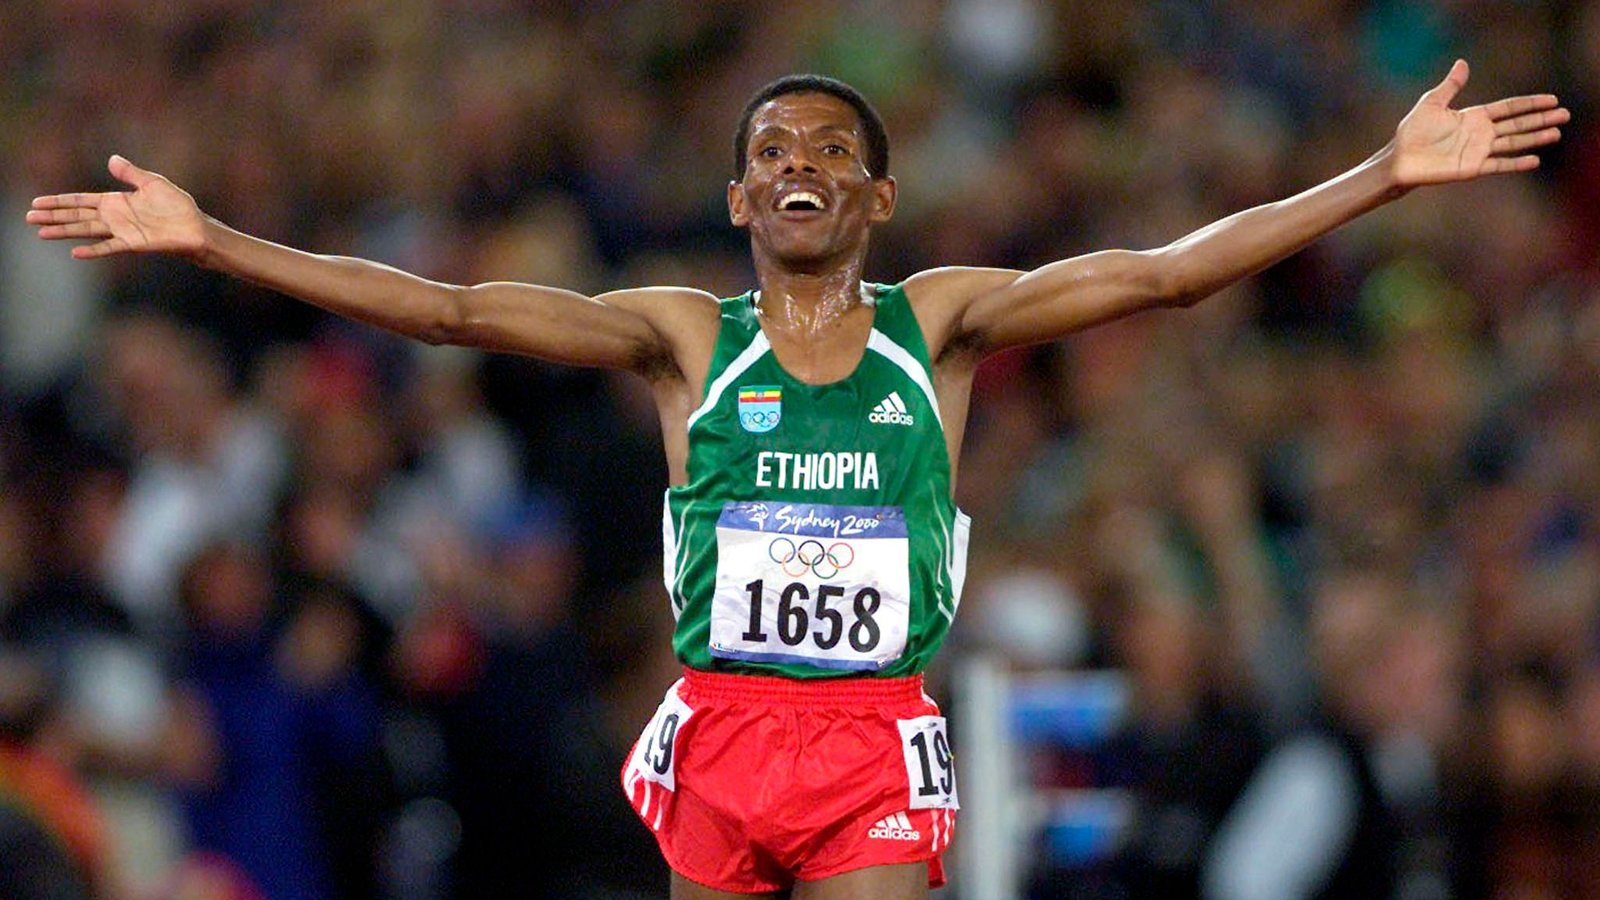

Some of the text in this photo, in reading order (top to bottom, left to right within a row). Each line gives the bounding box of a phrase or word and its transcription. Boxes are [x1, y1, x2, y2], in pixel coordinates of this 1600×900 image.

[868, 411, 914, 426] adidas
[756, 451, 880, 490] ETHIOPIA
[775, 505, 880, 538] Sydney 2000
[742, 579, 882, 653] 1658
[910, 730, 953, 796] 19
[868, 827, 920, 841] adidas
